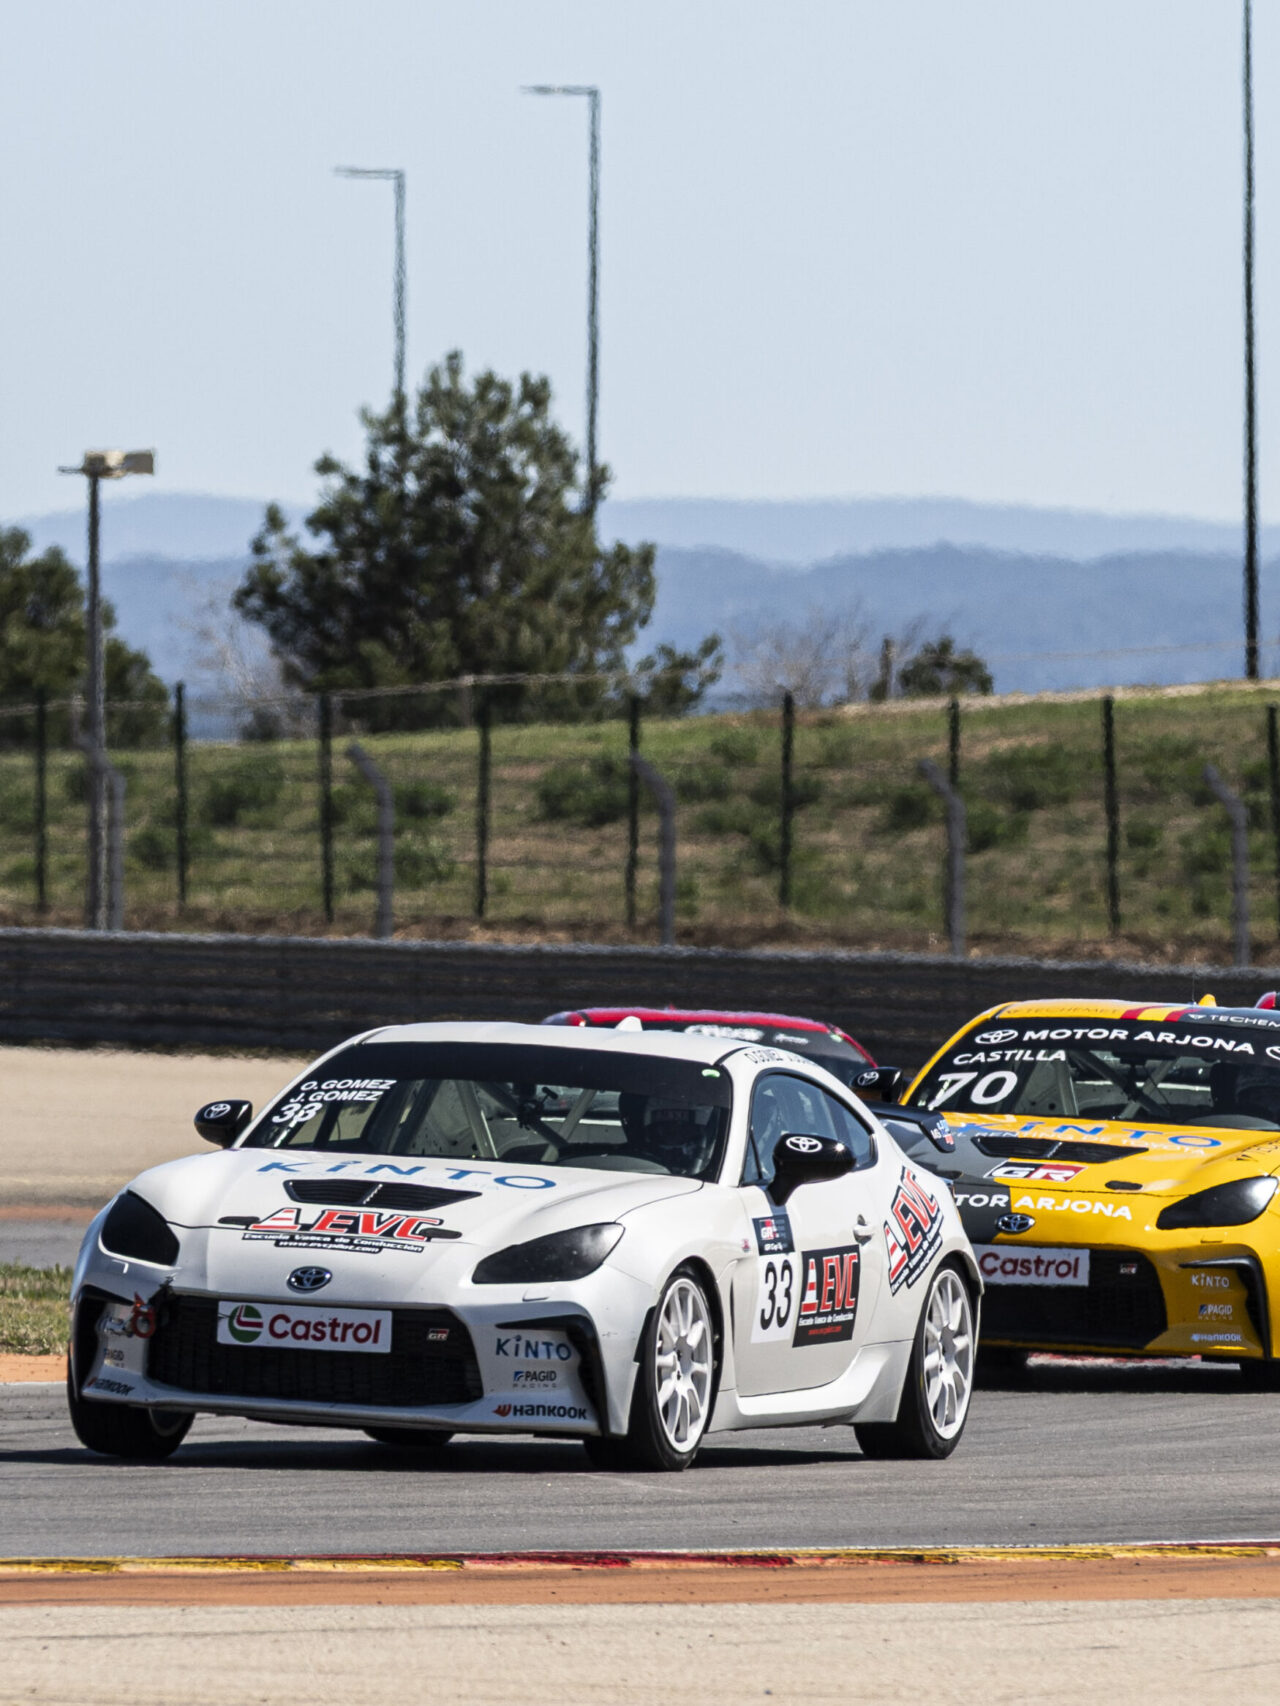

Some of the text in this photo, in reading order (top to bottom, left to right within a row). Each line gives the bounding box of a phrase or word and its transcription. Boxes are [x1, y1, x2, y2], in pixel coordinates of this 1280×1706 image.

[1022, 1029, 1255, 1055] MOTOR ARJONA
[952, 1049, 1067, 1066] CASTILLA
[308, 1090, 384, 1101] GOMEZ
[320, 1079, 398, 1090] GOMEZ
[928, 1069, 1018, 1111] 70
[271, 1102, 323, 1123] 33
[955, 1193, 1133, 1221] TOR ARJONA
[979, 1251, 1081, 1278] Castrol
[760, 1259, 793, 1330] 33
[1207, 1304, 1233, 1315] PAGID
[268, 1313, 382, 1344] Castrol
[524, 1370, 557, 1382] PAGID
